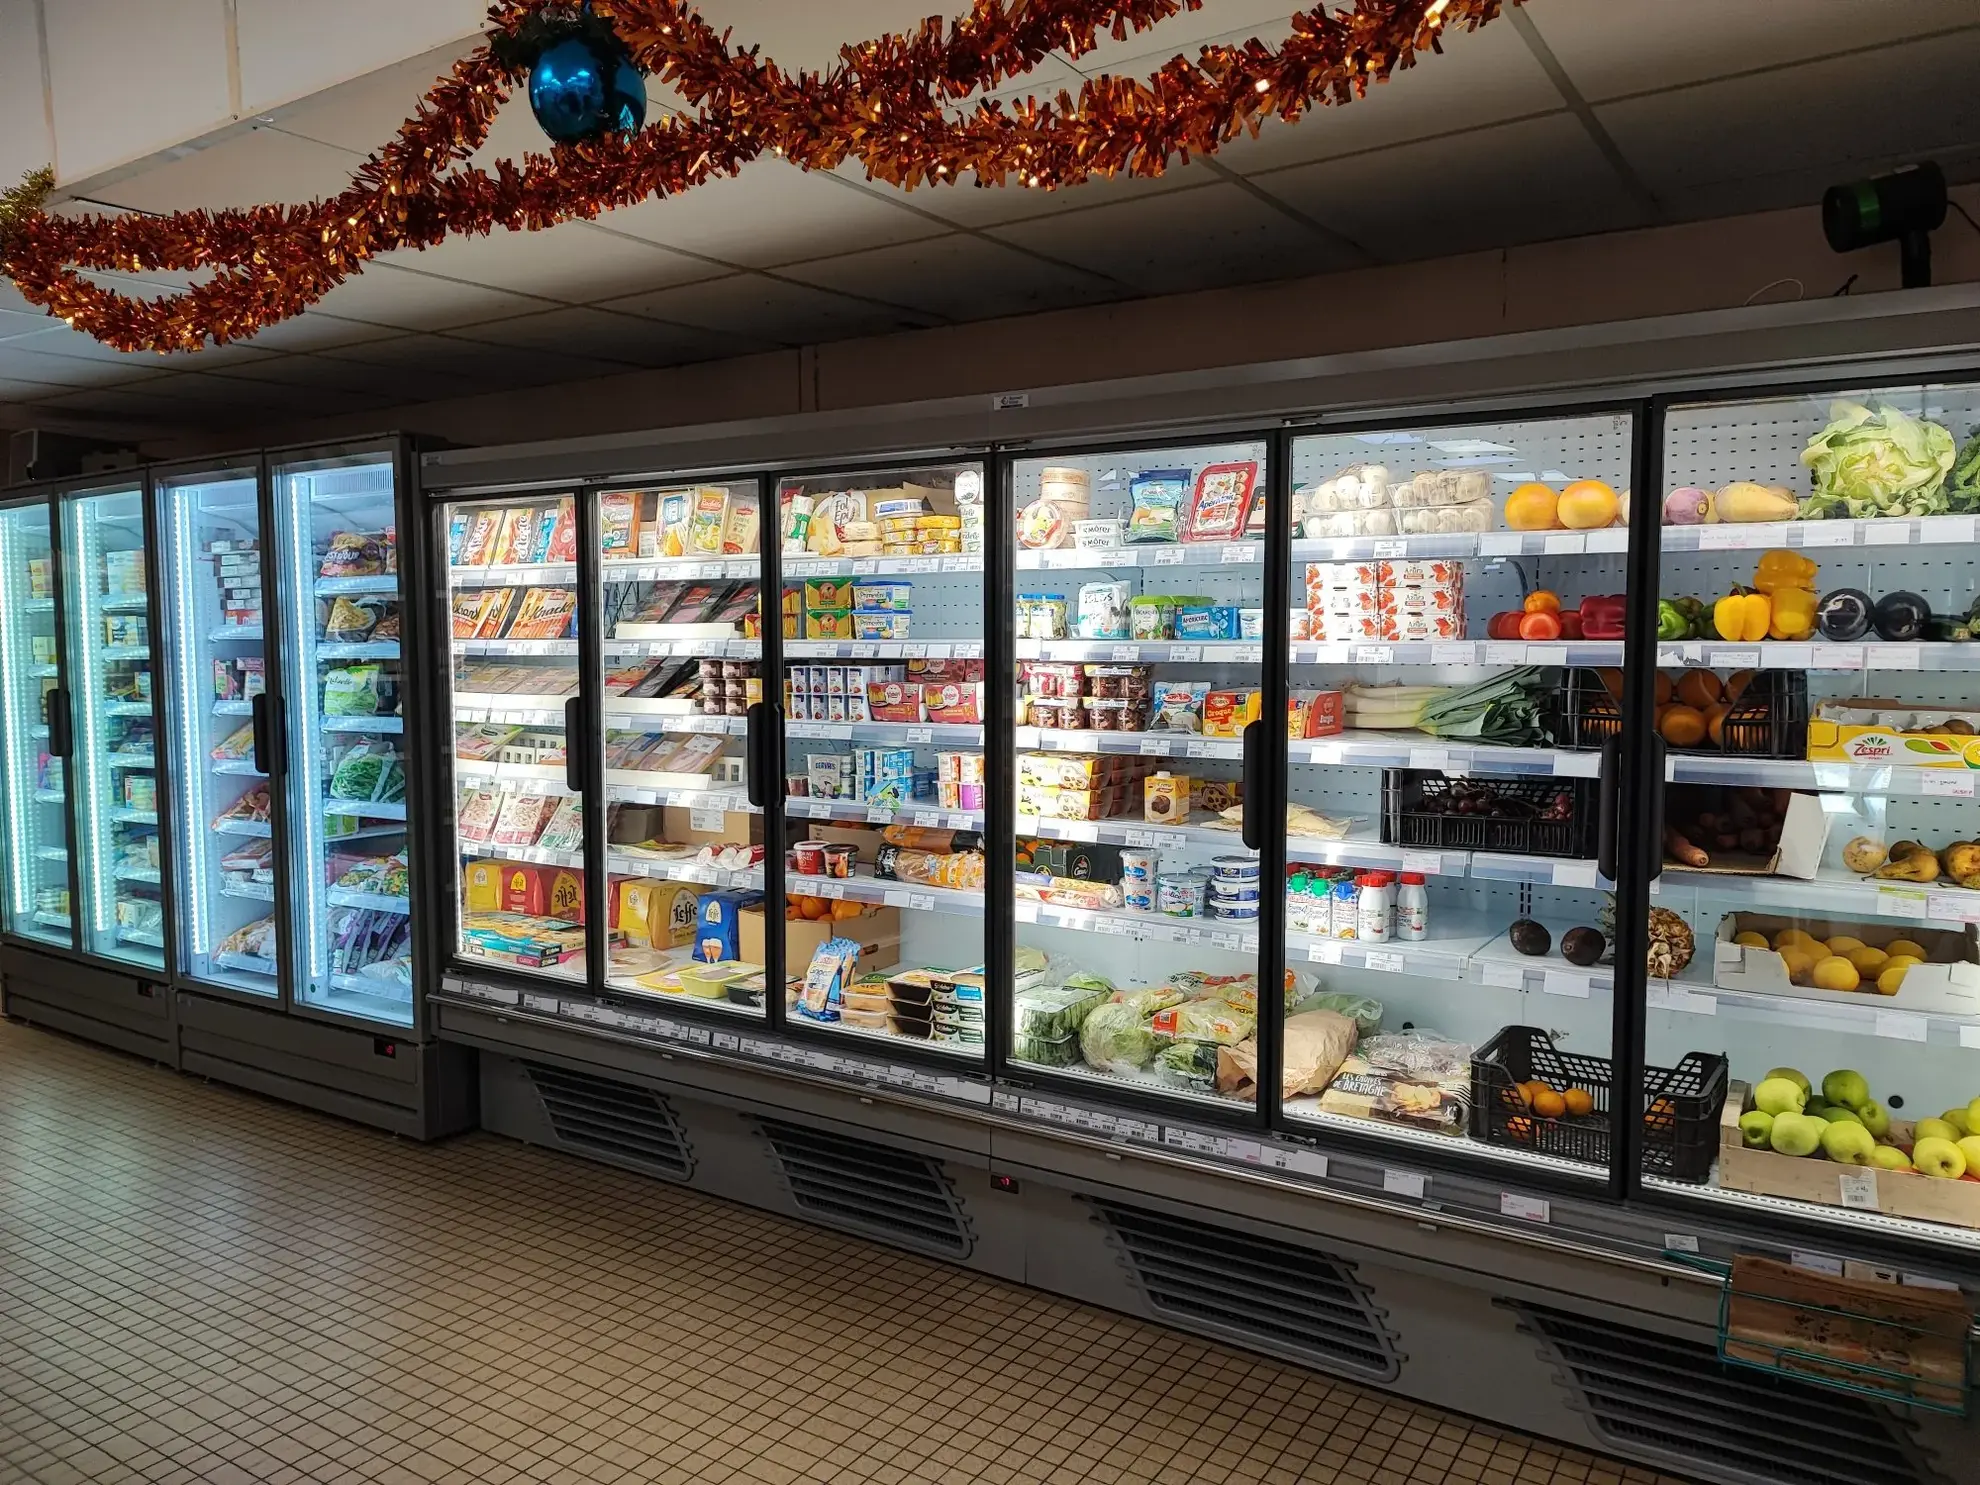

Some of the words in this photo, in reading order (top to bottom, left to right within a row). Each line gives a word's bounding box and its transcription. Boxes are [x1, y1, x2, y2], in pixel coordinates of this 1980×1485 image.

[835, 498, 849, 510] Fol
[834, 509, 849, 525] Epi
[1406, 593, 1425, 601] Azura
[1408, 620, 1427, 628] Azura
[1207, 708, 1232, 718] Croque
[1854, 743, 1891, 756] Zespri
[815, 762, 836, 770] GERVAIS
[673, 901, 698, 924] Leffe
[1342, 1072, 1354, 1080] LES
[1355, 1073, 1382, 1085] ENDIVES
[1332, 1080, 1342, 1088] DE
[1343, 1080, 1387, 1097] BRETAGNE
